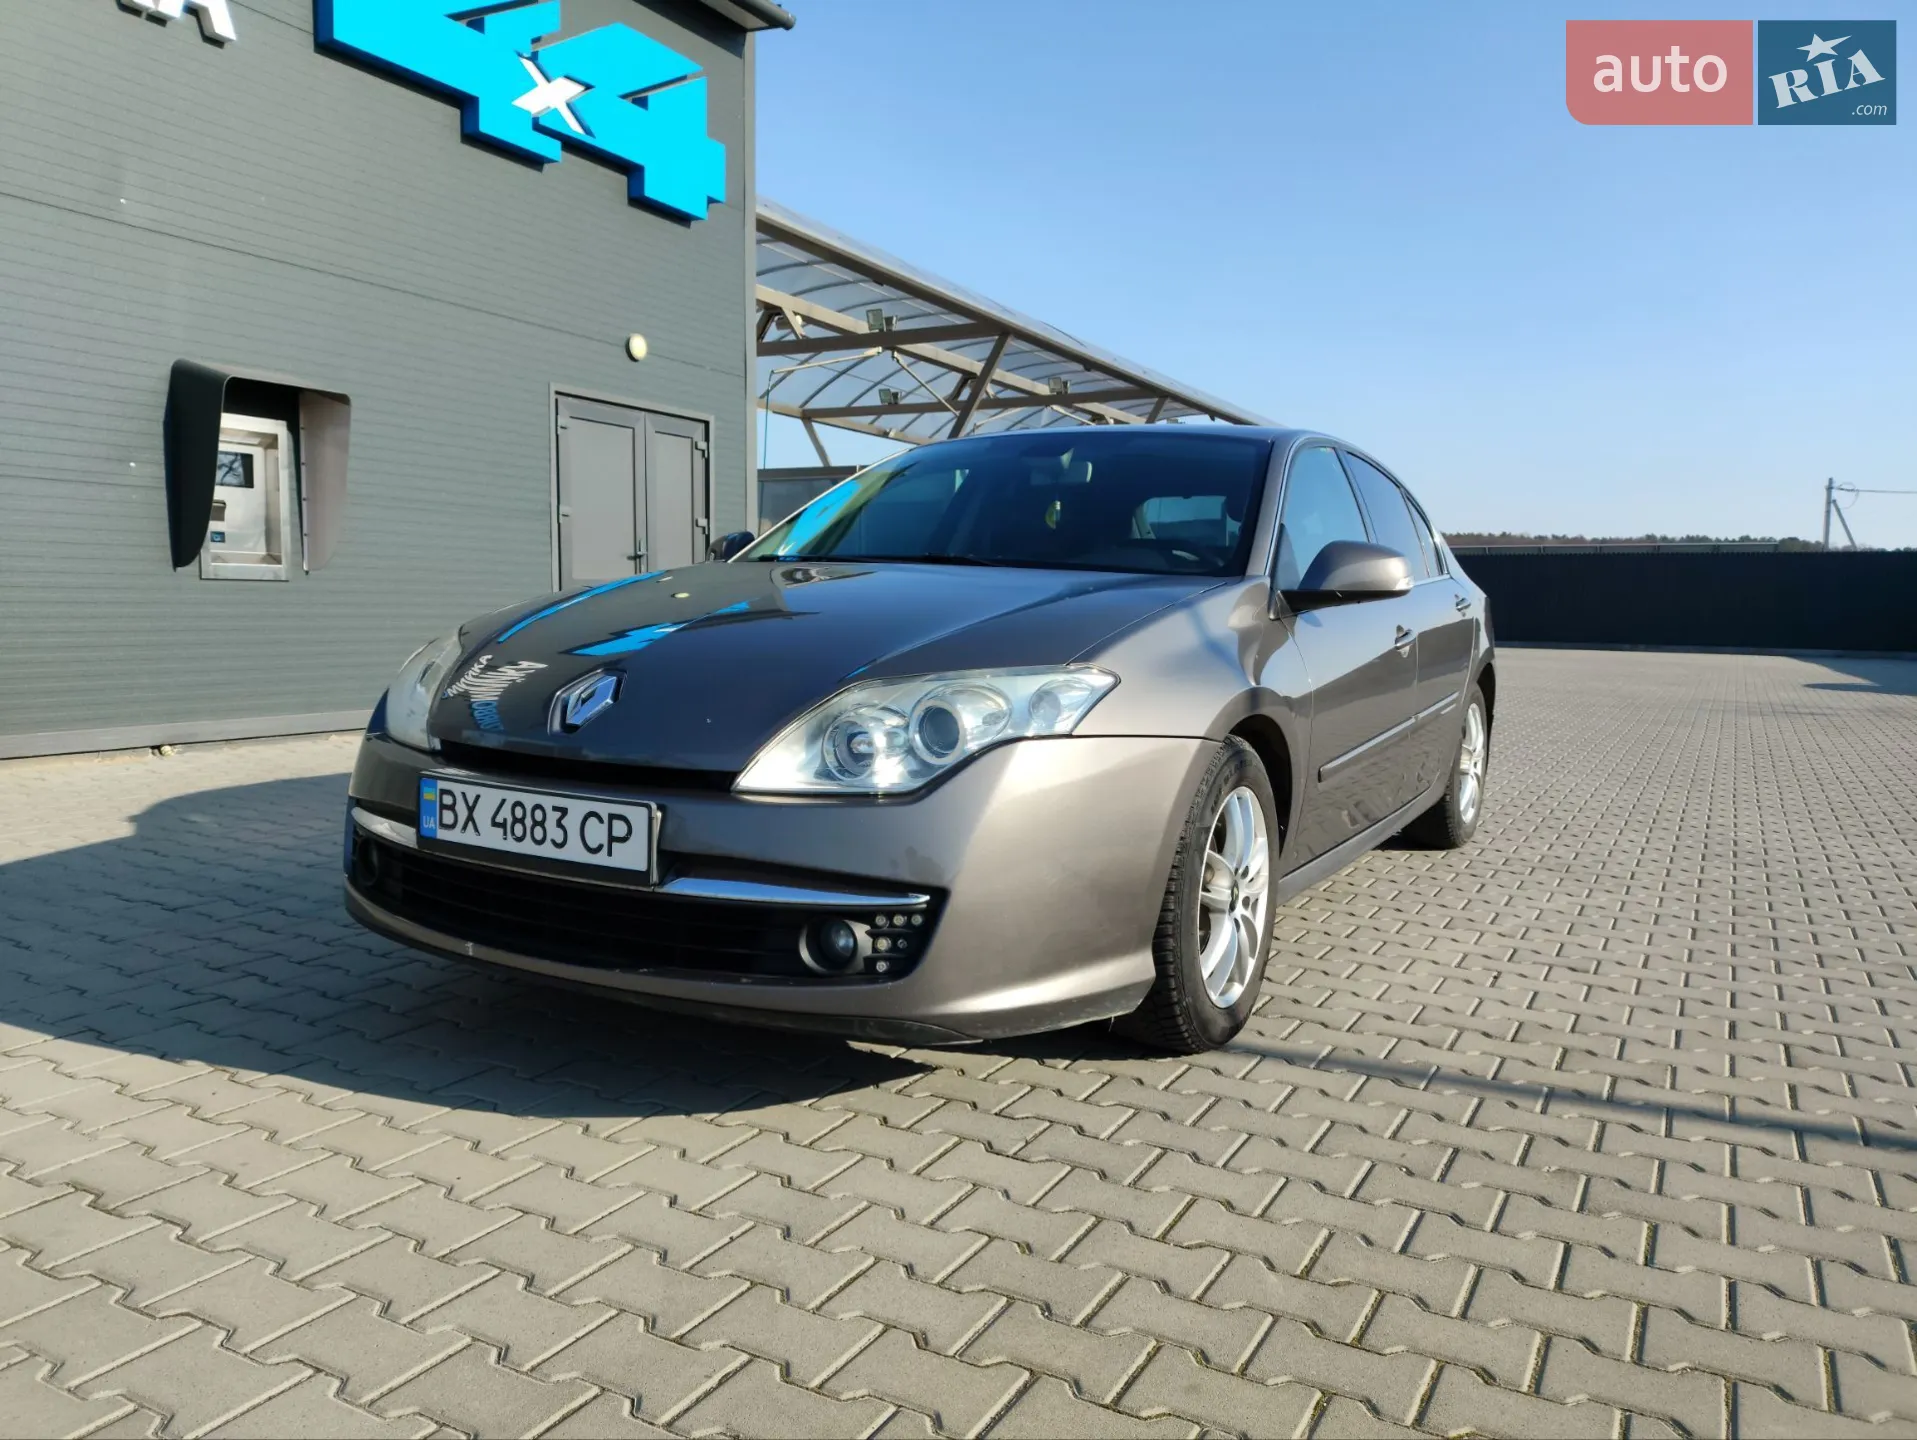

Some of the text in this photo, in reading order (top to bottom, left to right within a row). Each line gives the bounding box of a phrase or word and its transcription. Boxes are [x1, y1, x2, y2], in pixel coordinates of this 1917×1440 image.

[422, 815, 436, 829] UA
[438, 789, 633, 857] BX 4883 CP
